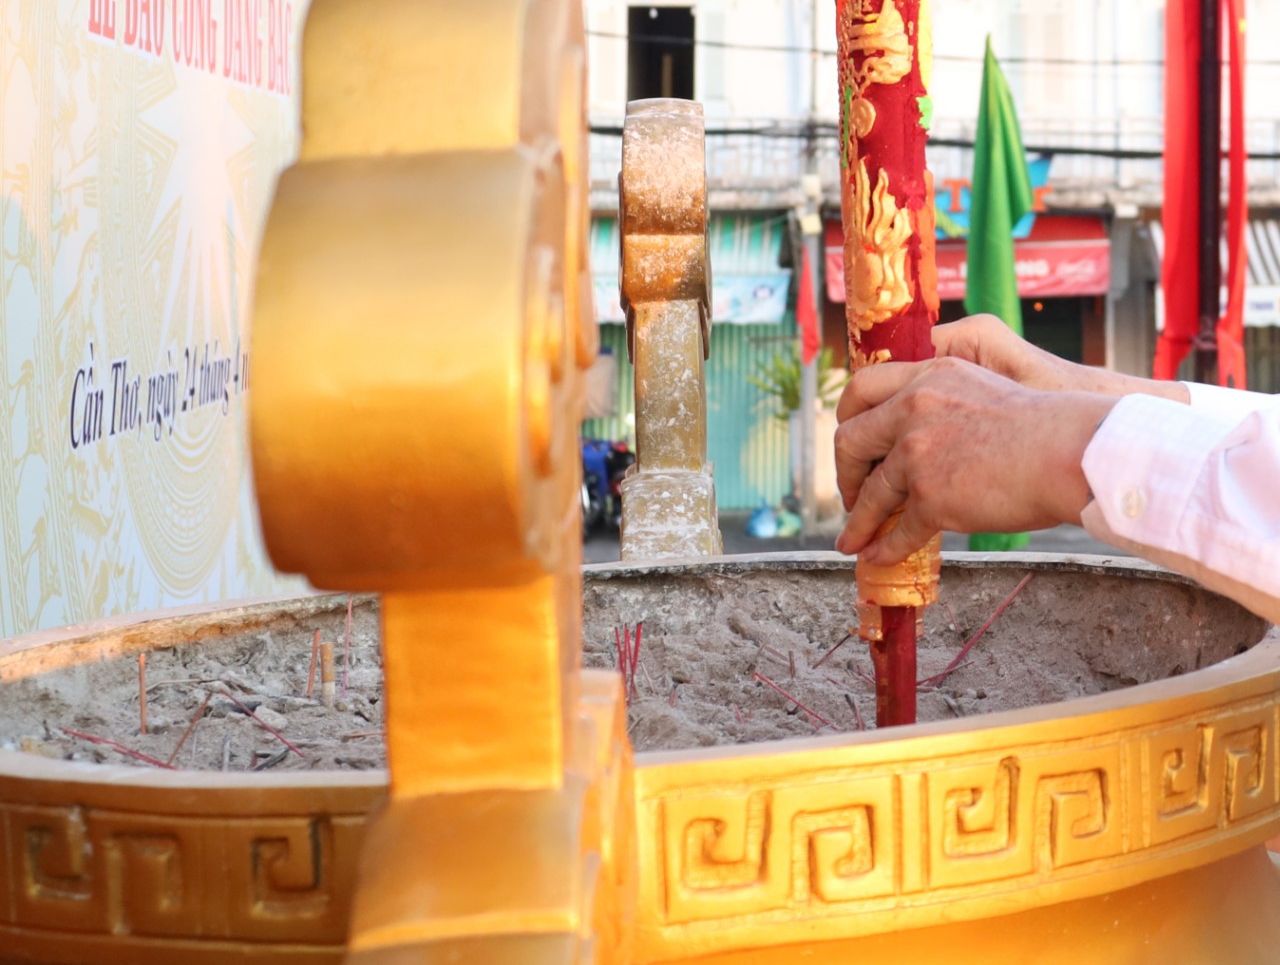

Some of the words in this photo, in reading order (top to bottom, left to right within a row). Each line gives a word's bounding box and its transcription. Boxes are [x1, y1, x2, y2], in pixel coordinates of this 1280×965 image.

[70, 341, 104, 449] Cần
[109, 359, 142, 443] Thơ,
[146, 349, 179, 442] ngày
[181, 345, 198, 412] 24
[198, 339, 231, 416] tháng
[233, 335, 241, 395] 4
